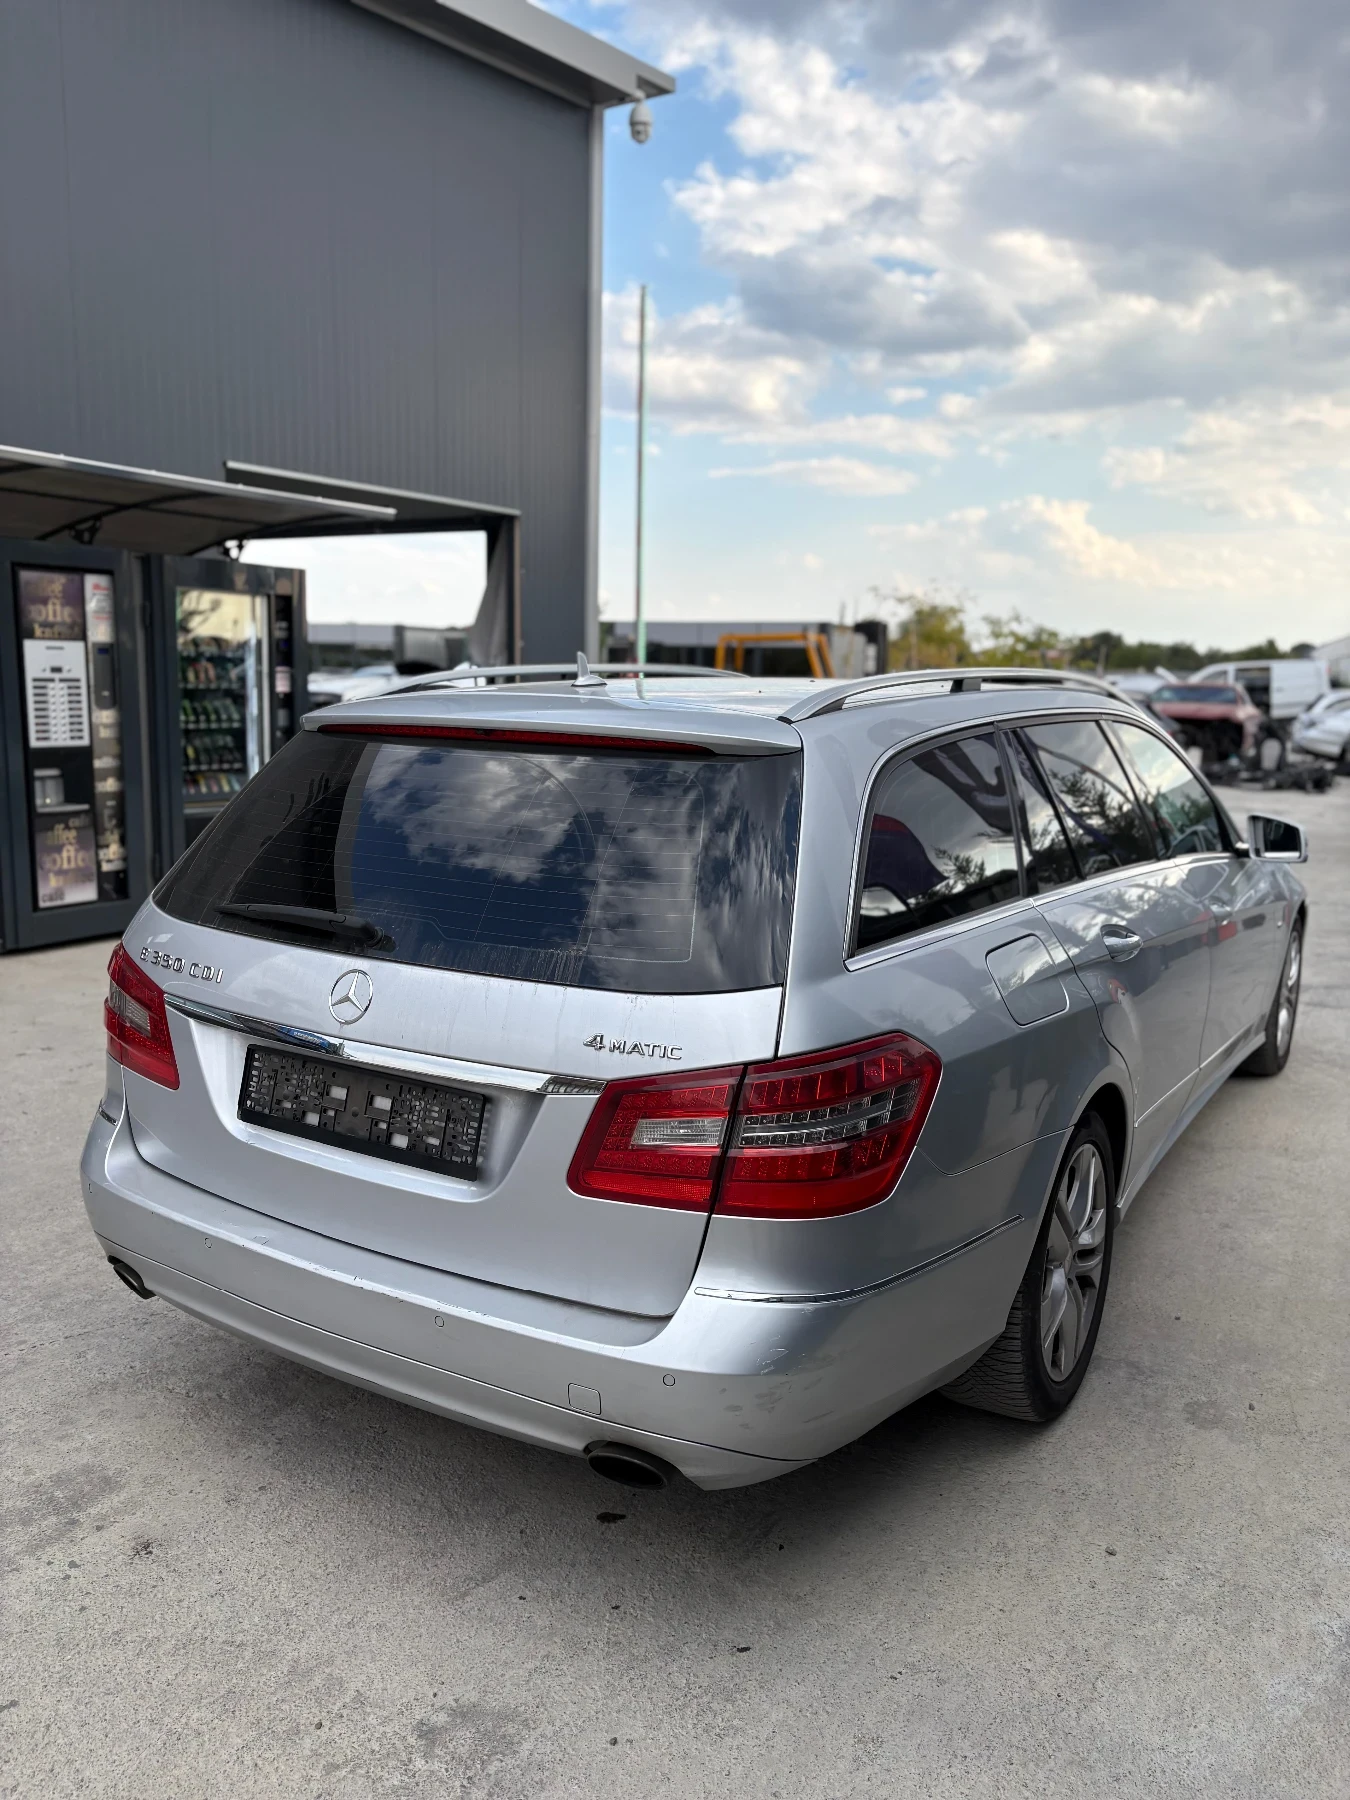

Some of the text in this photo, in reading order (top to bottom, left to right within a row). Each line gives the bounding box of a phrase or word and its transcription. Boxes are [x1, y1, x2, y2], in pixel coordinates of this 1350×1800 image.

[140, 947, 223, 983] E 350 CDI
